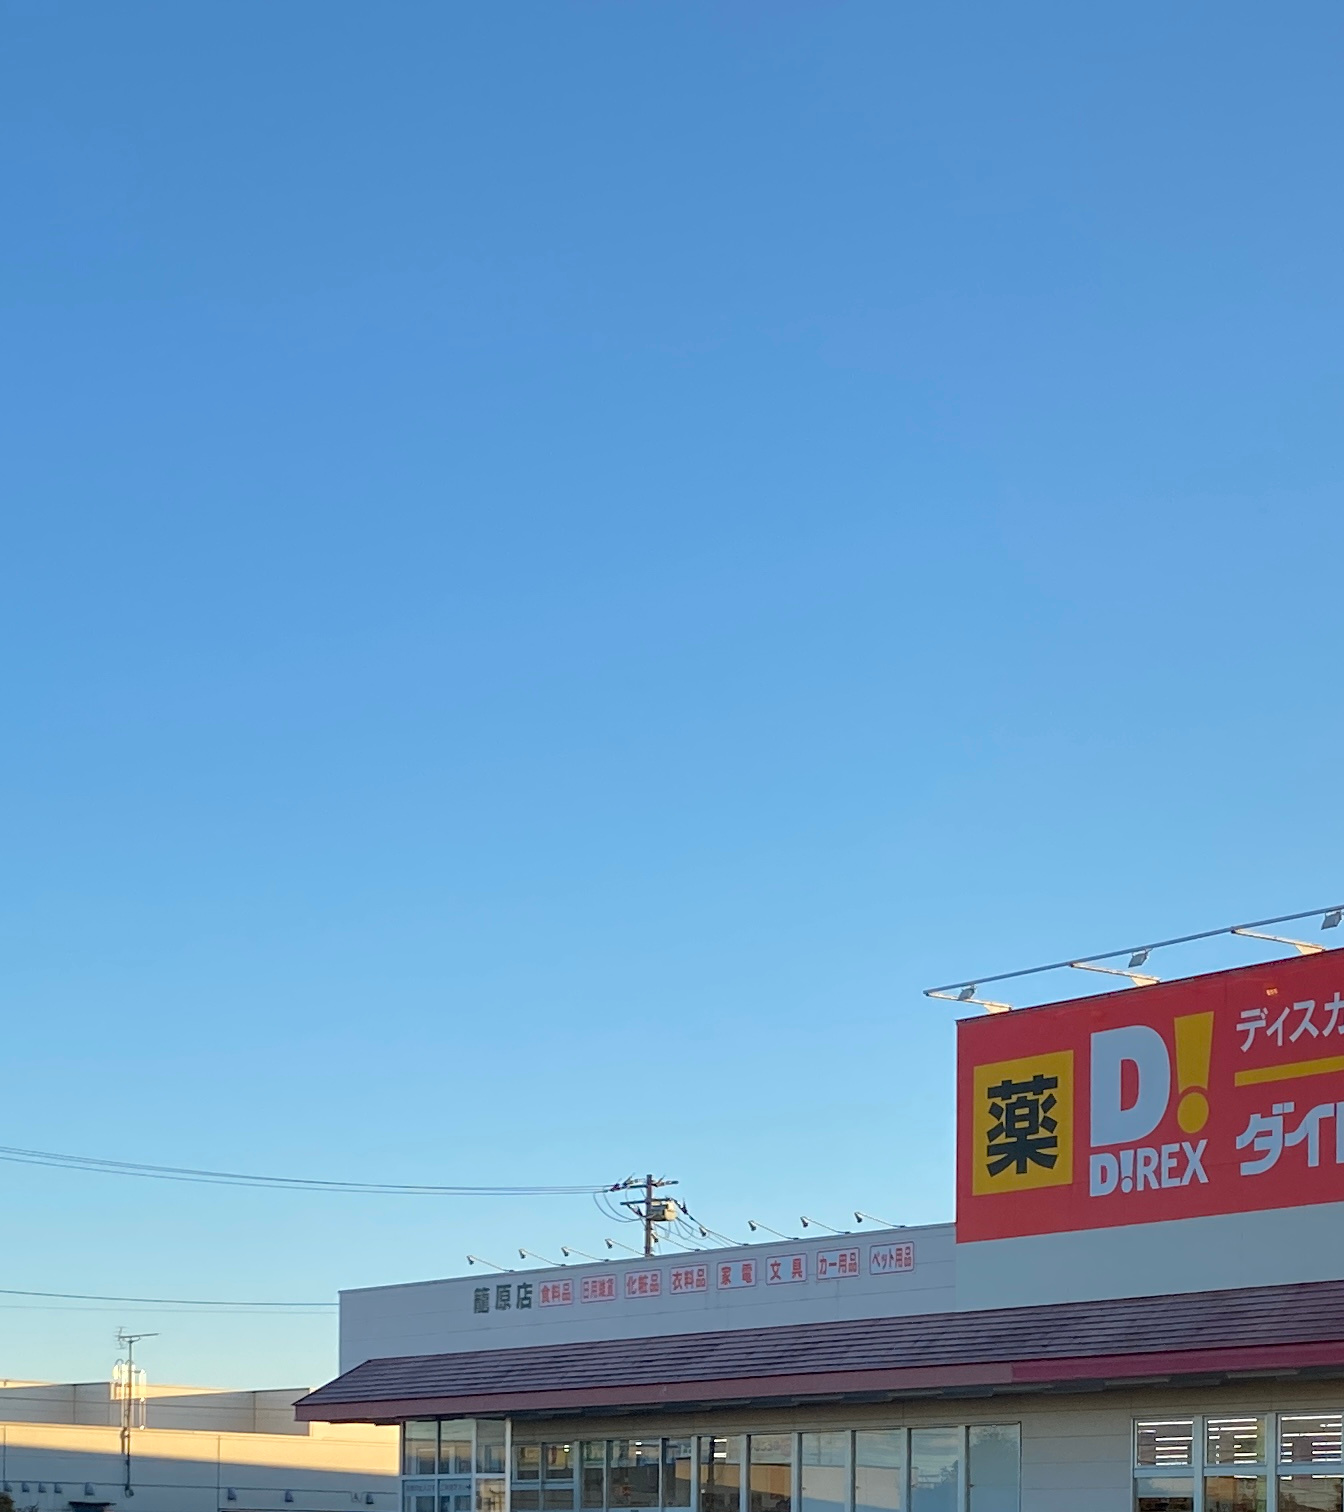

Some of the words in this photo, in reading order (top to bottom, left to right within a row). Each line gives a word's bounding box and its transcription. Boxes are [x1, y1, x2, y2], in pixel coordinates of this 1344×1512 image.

[987, 1074, 1058, 1178] 薬
[770, 1258, 803, 1281] 文具
[819, 1252, 858, 1276] カー用品
[872, 1246, 912, 1270] ペット用品
[626, 1273, 659, 1295] 化粧品
[672, 1268, 706, 1291] 衣料品
[720, 1263, 753, 1286] 家電
[541, 1283, 571, 1303] 食料品
